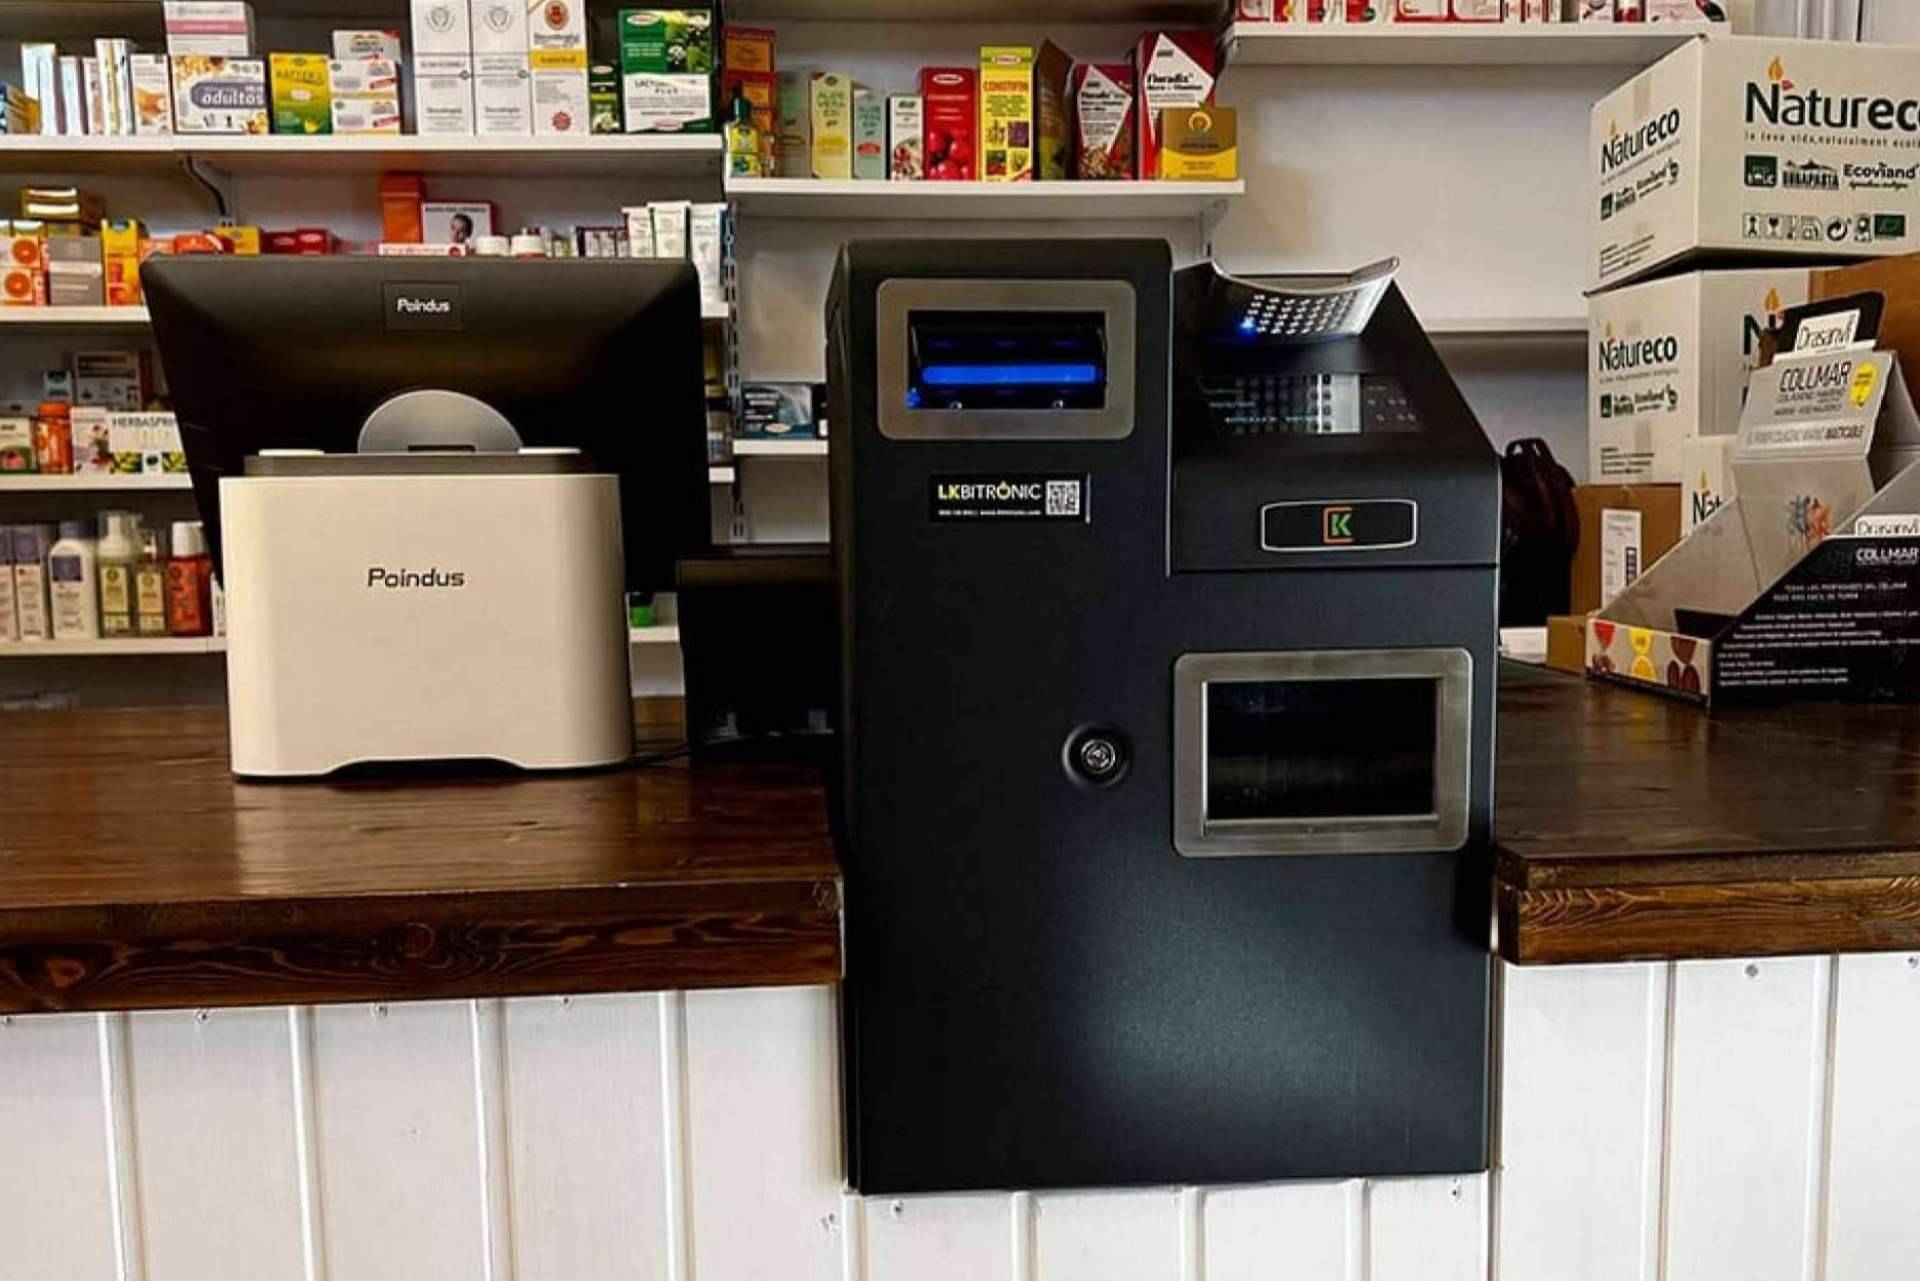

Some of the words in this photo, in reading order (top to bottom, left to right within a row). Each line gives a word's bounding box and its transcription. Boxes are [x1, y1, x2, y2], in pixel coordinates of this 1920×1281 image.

[1745, 81, 1920, 132] Naturec
[1601, 108, 1680, 174] Natureco
[397, 298, 450, 313] Poindus
[1599, 335, 1678, 372] Natureco
[1779, 360, 1852, 393] COLLMAR
[1856, 547, 1919, 562] COLLMAR
[367, 567, 465, 588] Poindus
